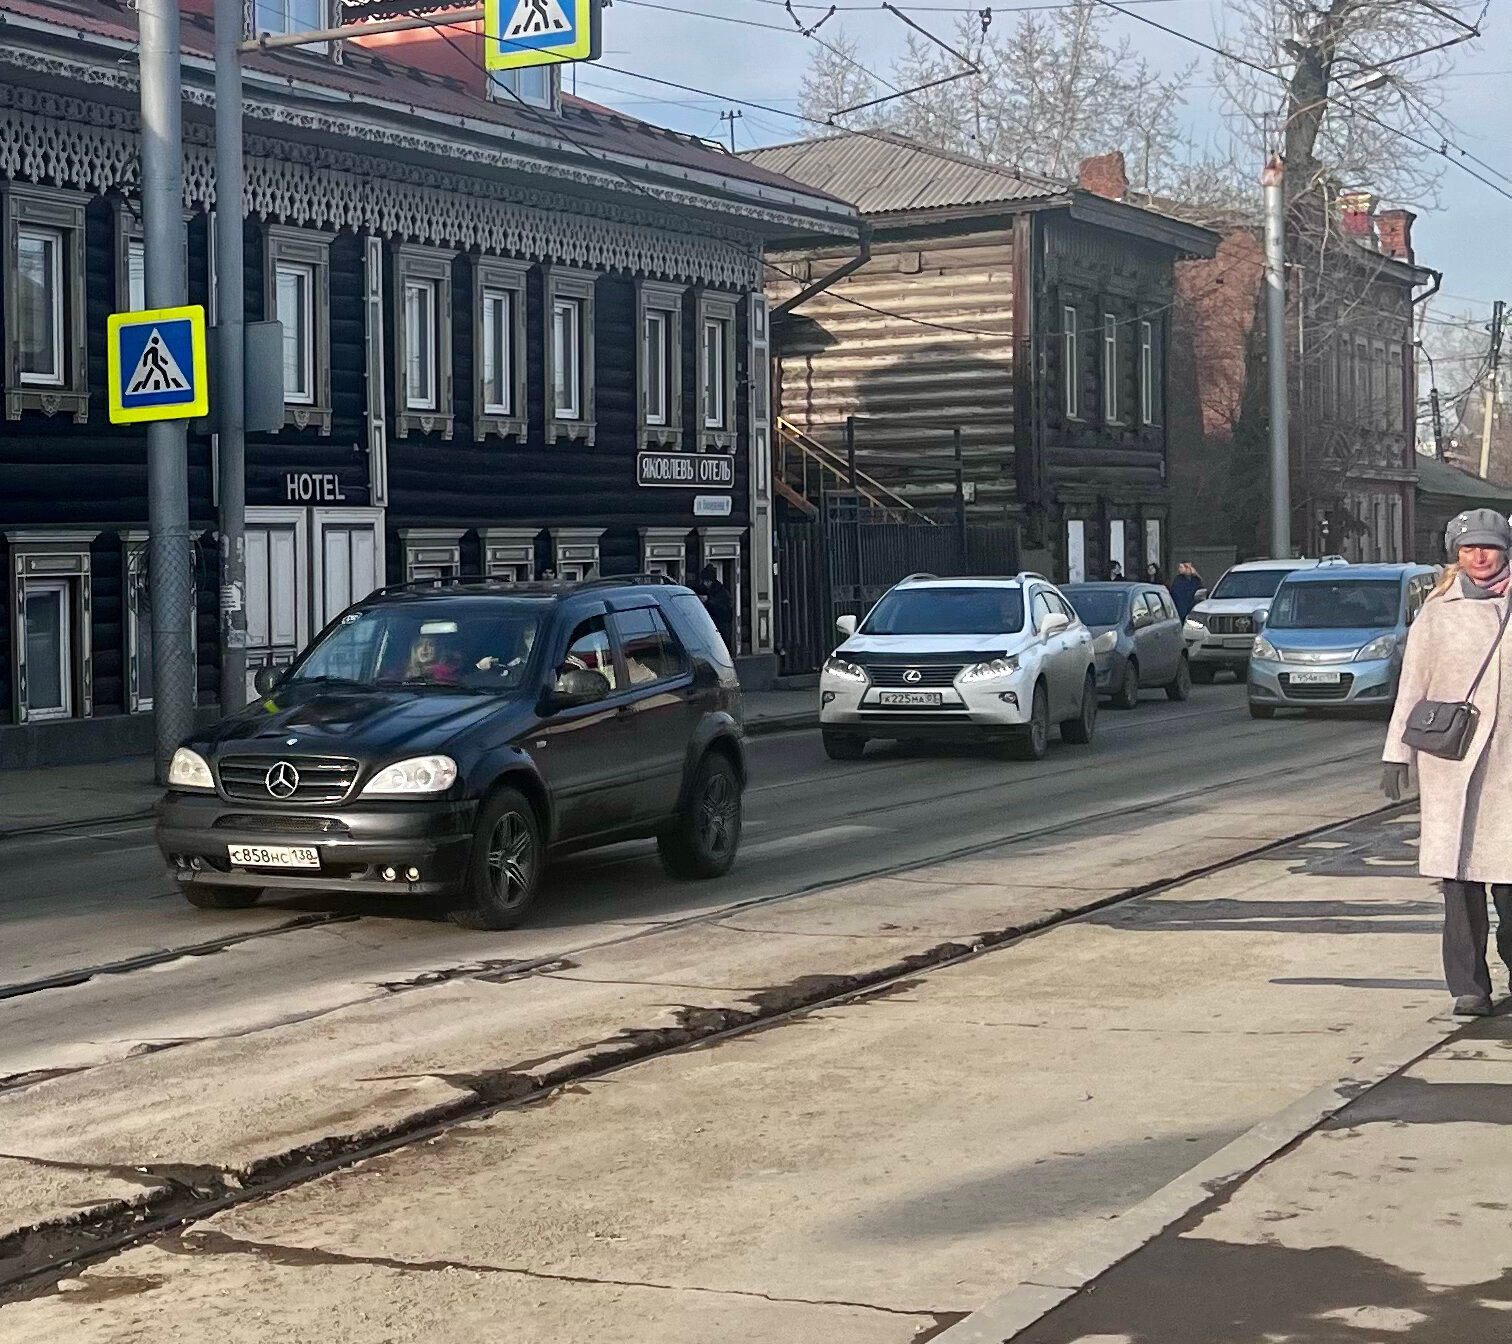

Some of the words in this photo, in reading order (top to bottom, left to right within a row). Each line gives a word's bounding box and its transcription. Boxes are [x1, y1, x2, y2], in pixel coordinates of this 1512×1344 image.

[642, 457, 694, 480] ЯКОВЛЕВЪ
[700, 459, 731, 481] ОТЕЛЬ
[286, 473, 346, 501] HOTEL
